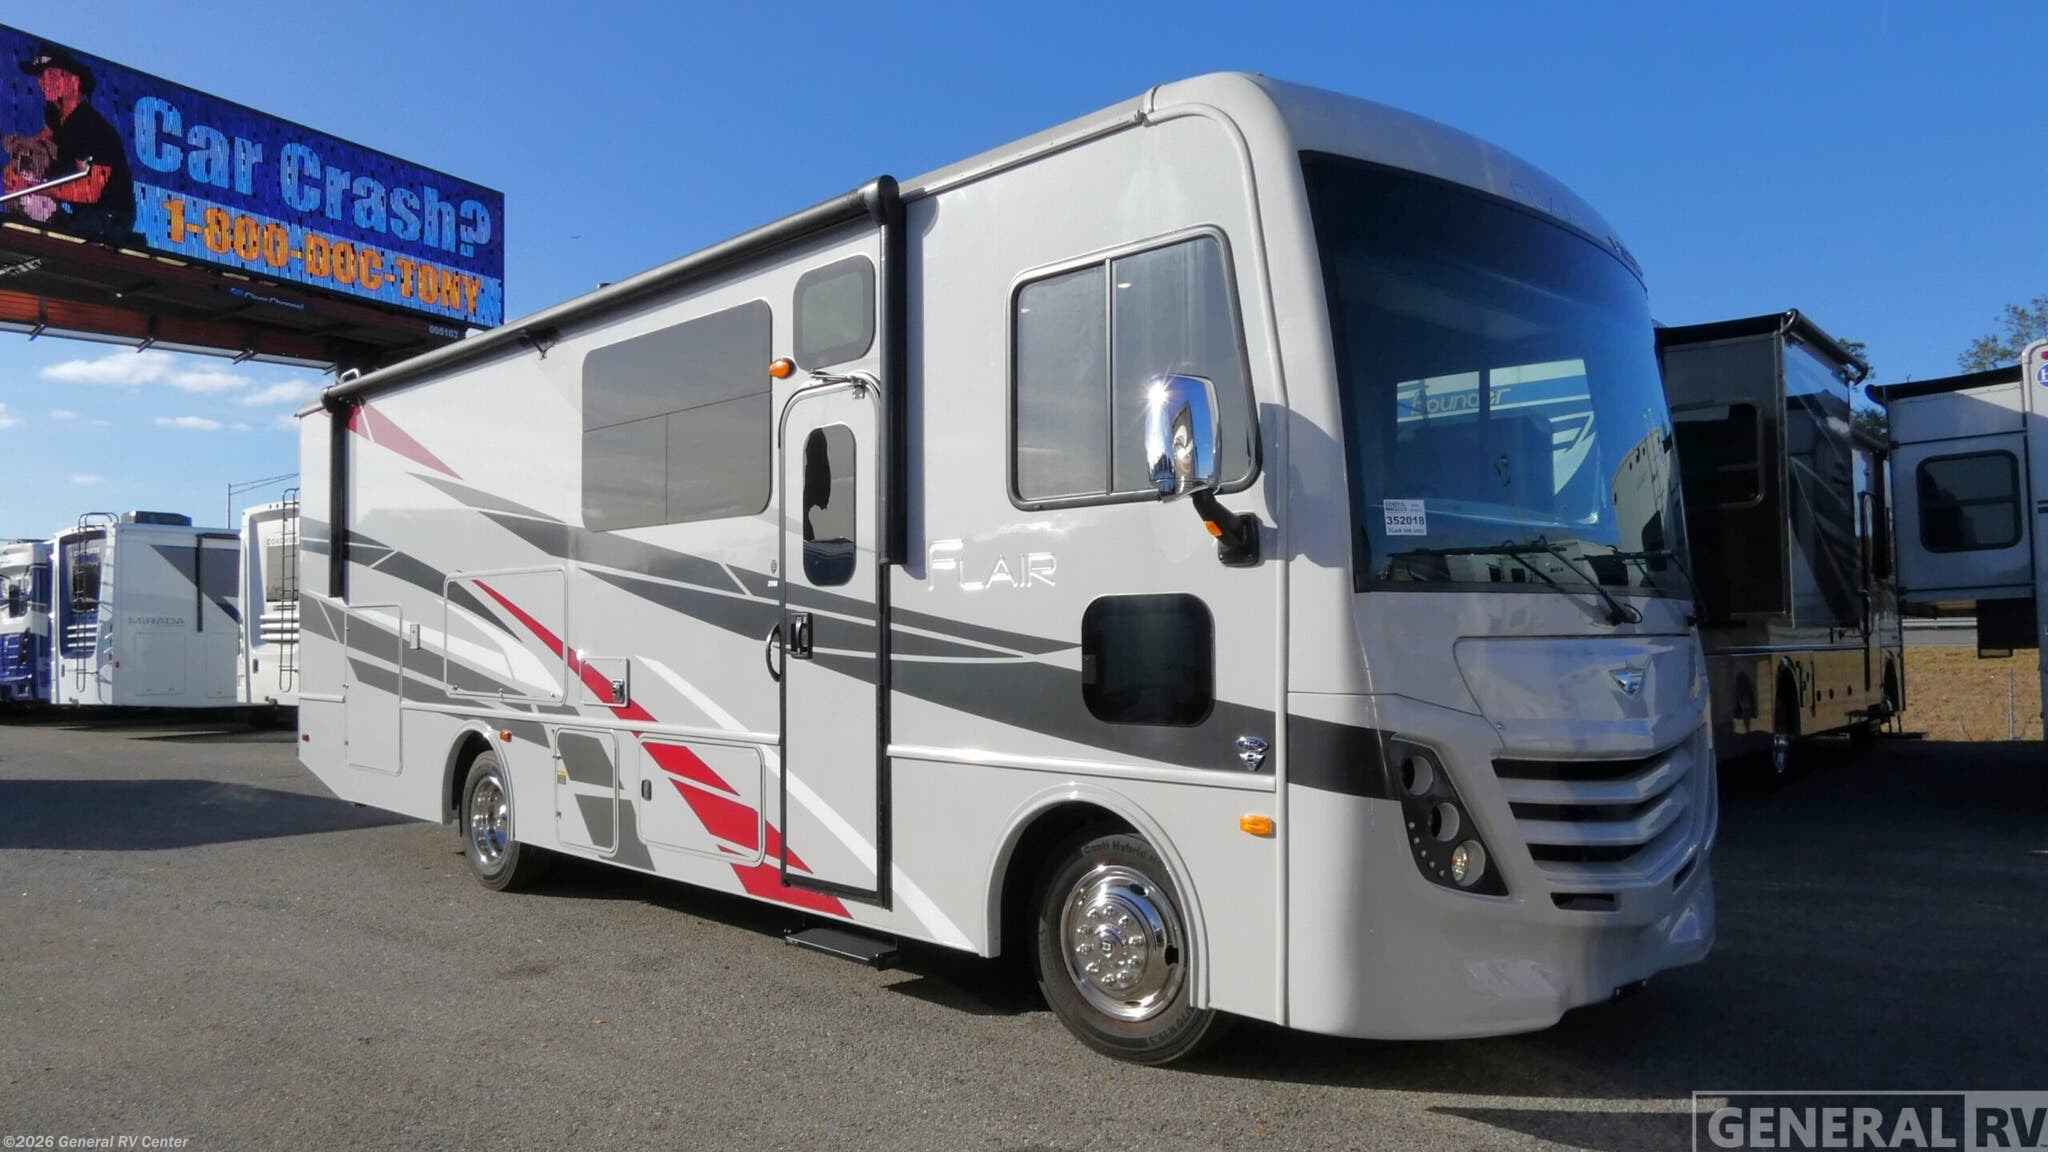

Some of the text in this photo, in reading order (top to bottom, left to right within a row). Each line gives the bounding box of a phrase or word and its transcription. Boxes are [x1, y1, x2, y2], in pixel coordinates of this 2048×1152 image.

[134, 96, 492, 258] Car Crash?
[162, 199, 482, 314] 1-800-DOC-TONY
[1386, 515, 1425, 526] 352018
[928, 539, 1057, 591] FLAIR
[128, 616, 185, 625] MIRADA
